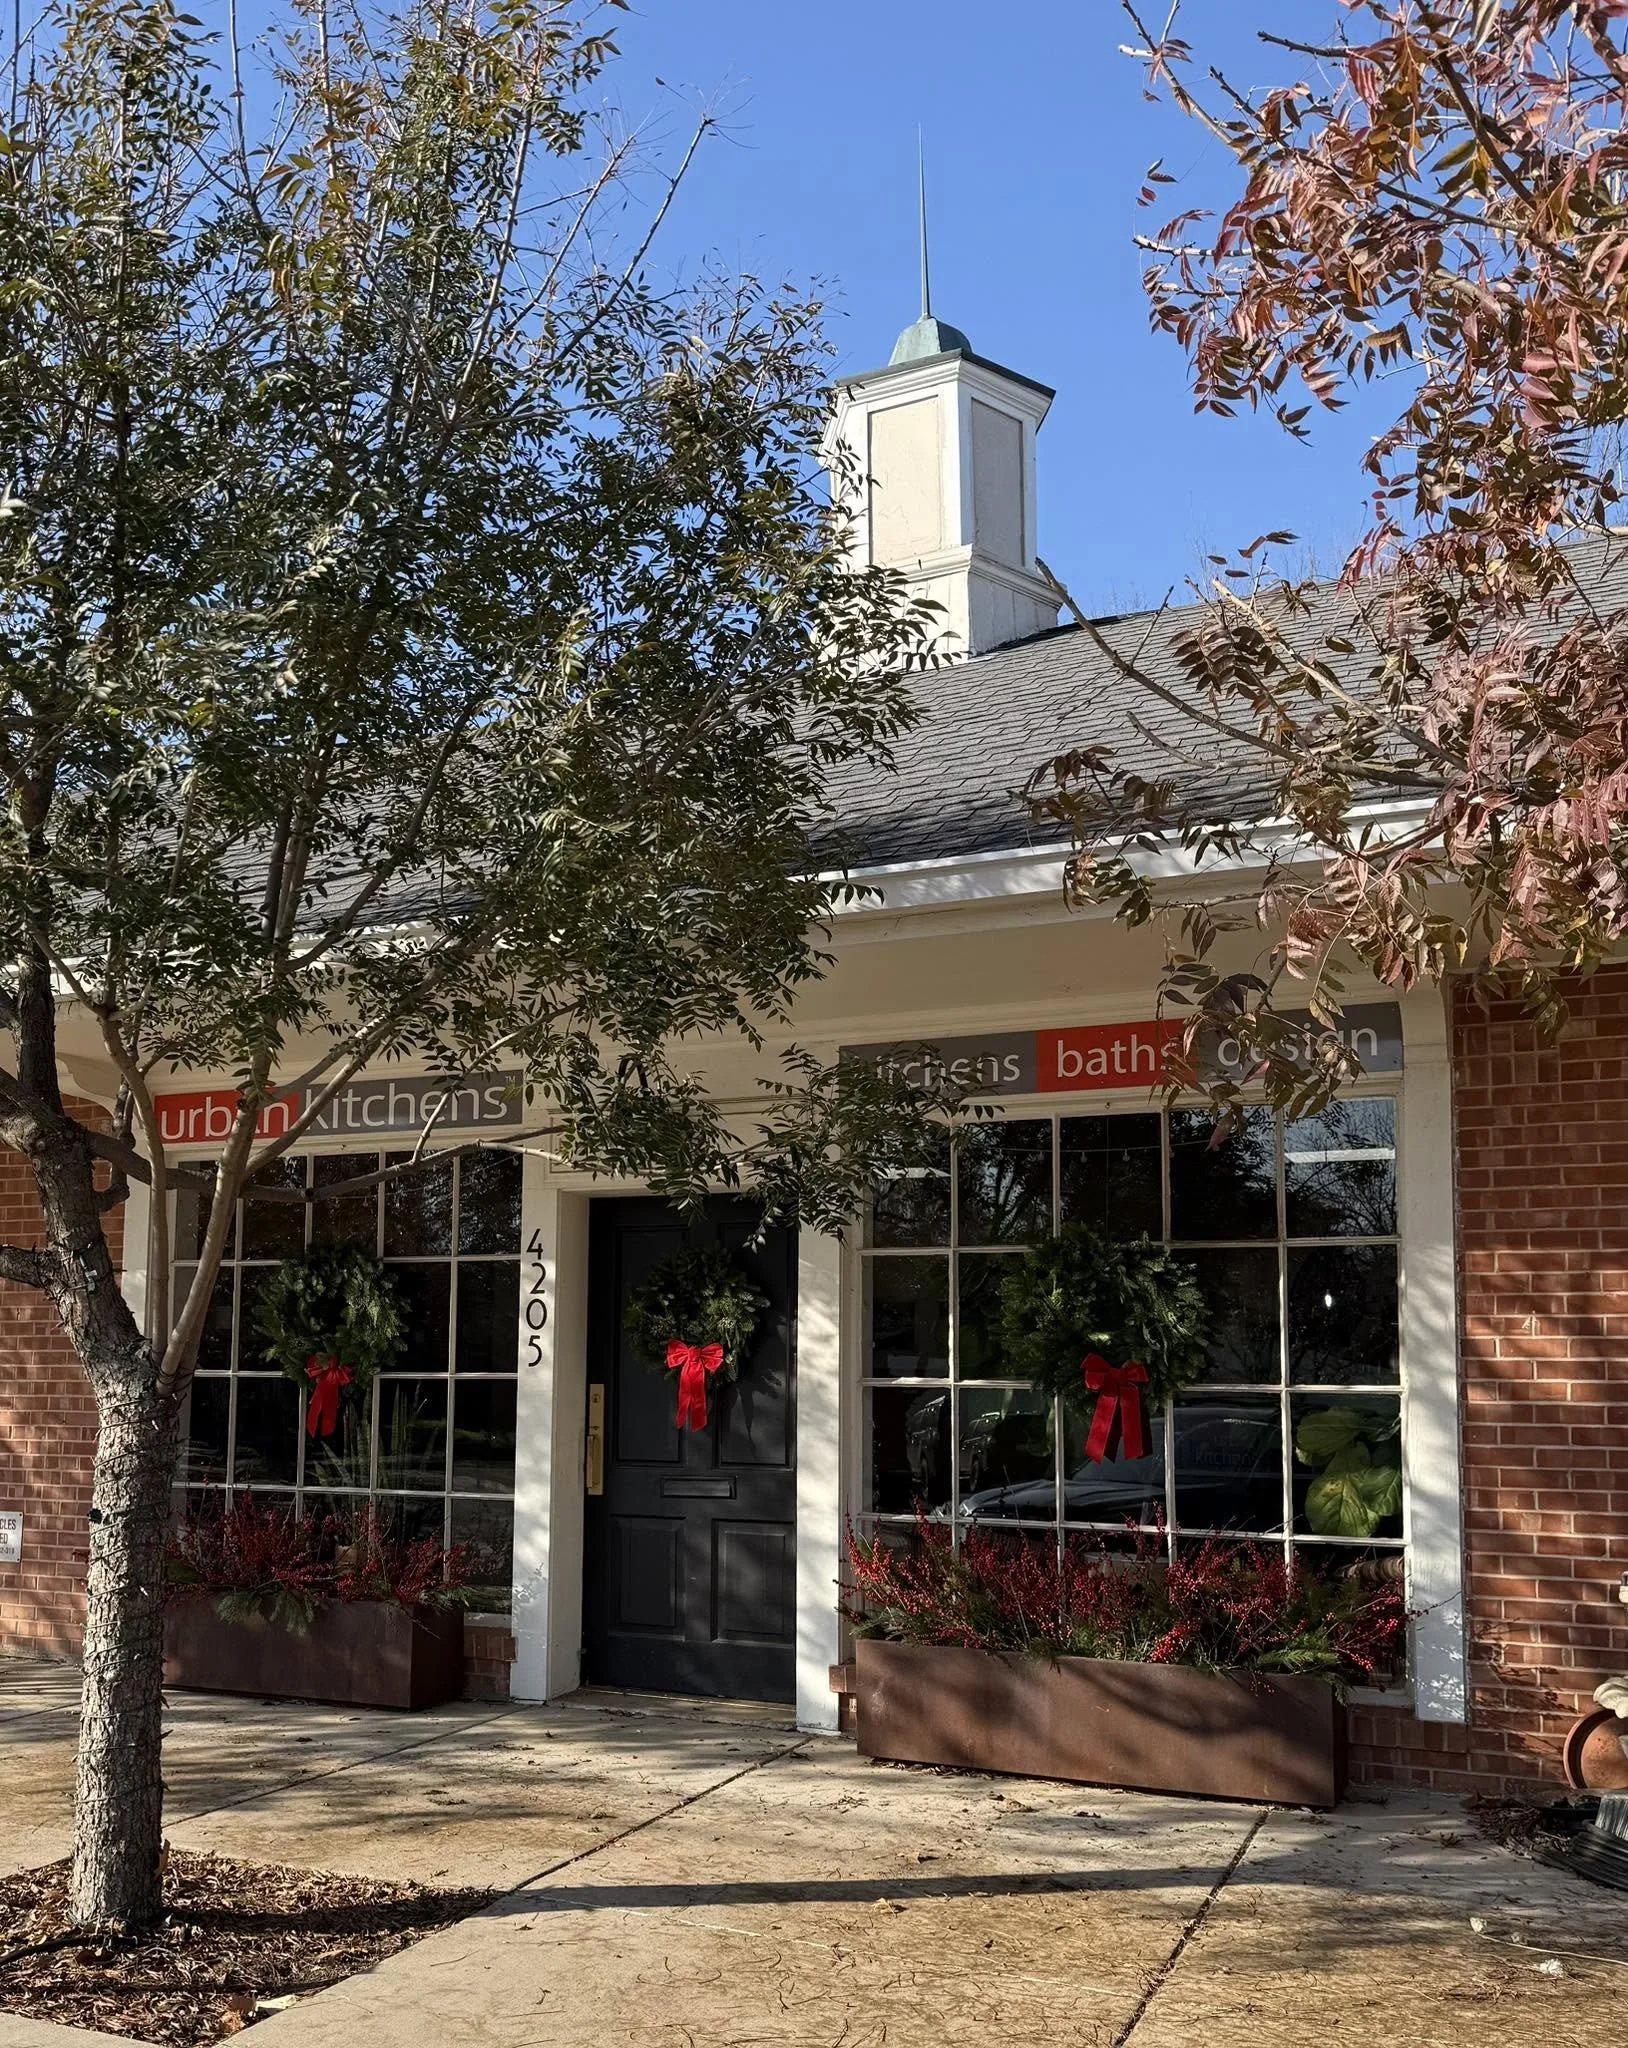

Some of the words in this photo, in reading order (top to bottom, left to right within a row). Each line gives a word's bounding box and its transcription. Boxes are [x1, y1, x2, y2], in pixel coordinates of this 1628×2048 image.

[853, 1049, 1020, 1091] itchens
[161, 1096, 289, 1140] urbn
[305, 1082, 508, 1131] kitchens
[526, 1228, 548, 1367] 4205
